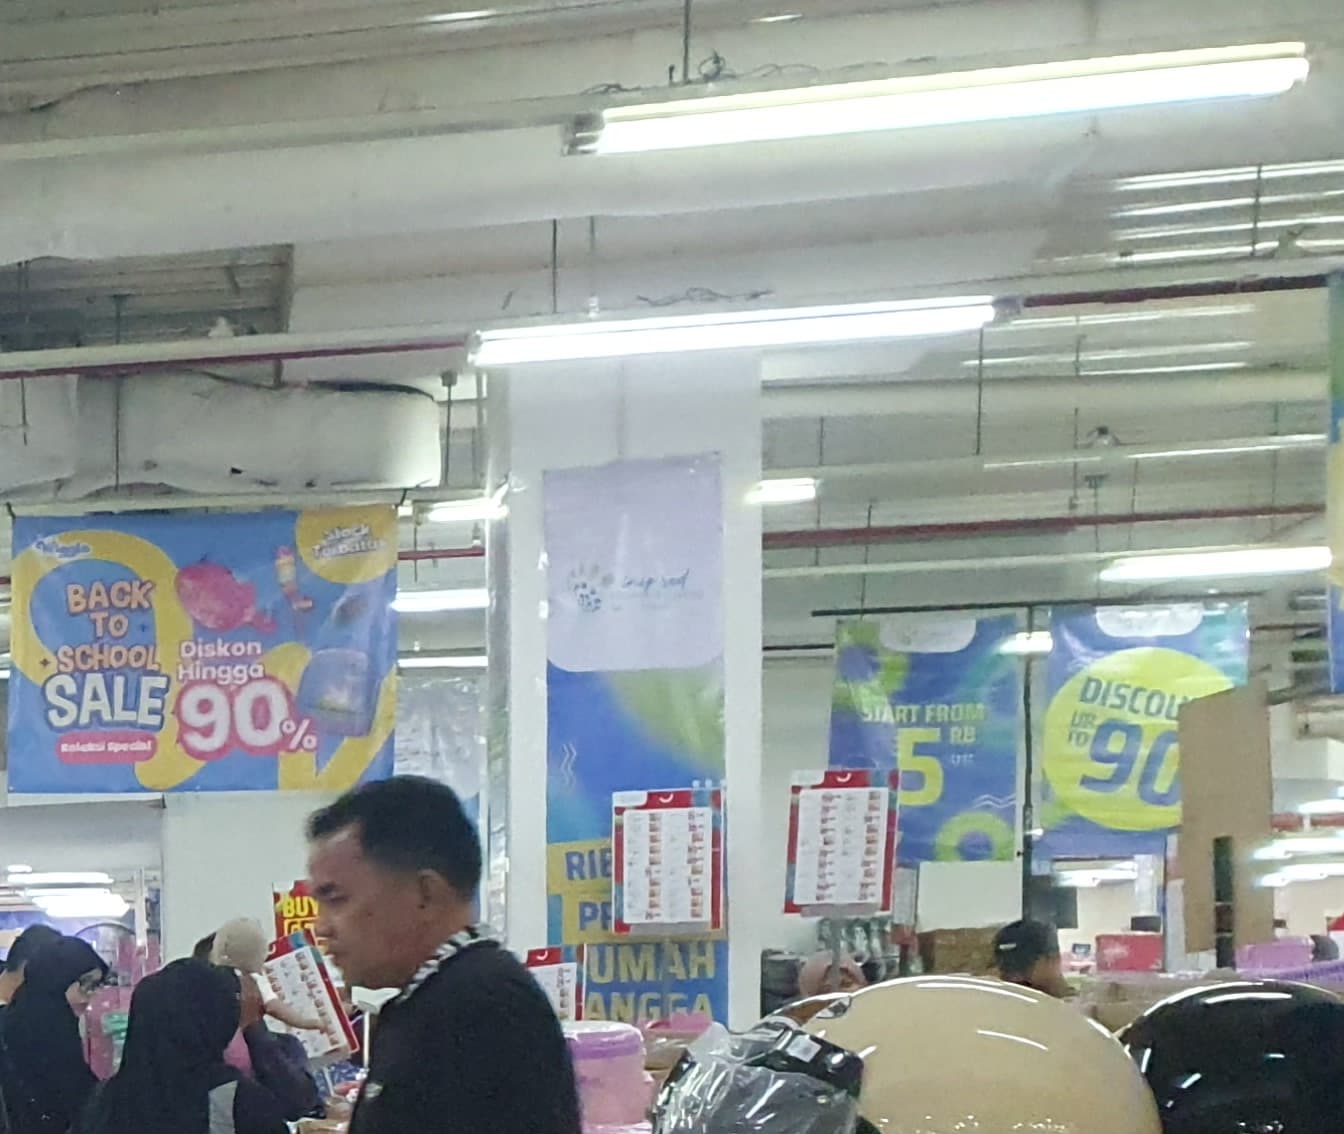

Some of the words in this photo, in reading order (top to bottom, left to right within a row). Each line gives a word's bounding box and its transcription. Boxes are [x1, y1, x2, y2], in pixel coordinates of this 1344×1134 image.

[65, 579, 155, 615] BACK
[89, 610, 130, 638] TO
[56, 643, 161, 673] SCHOOL
[179, 640, 263, 660] Diskon
[177, 659, 266, 686] Hingga
[45, 672, 169, 728] SALE
[862, 703, 921, 723] START
[925, 702, 986, 723] FROM
[180, 682, 319, 753] 90%
[949, 726, 977, 745] RB
[896, 727, 944, 806] 5
